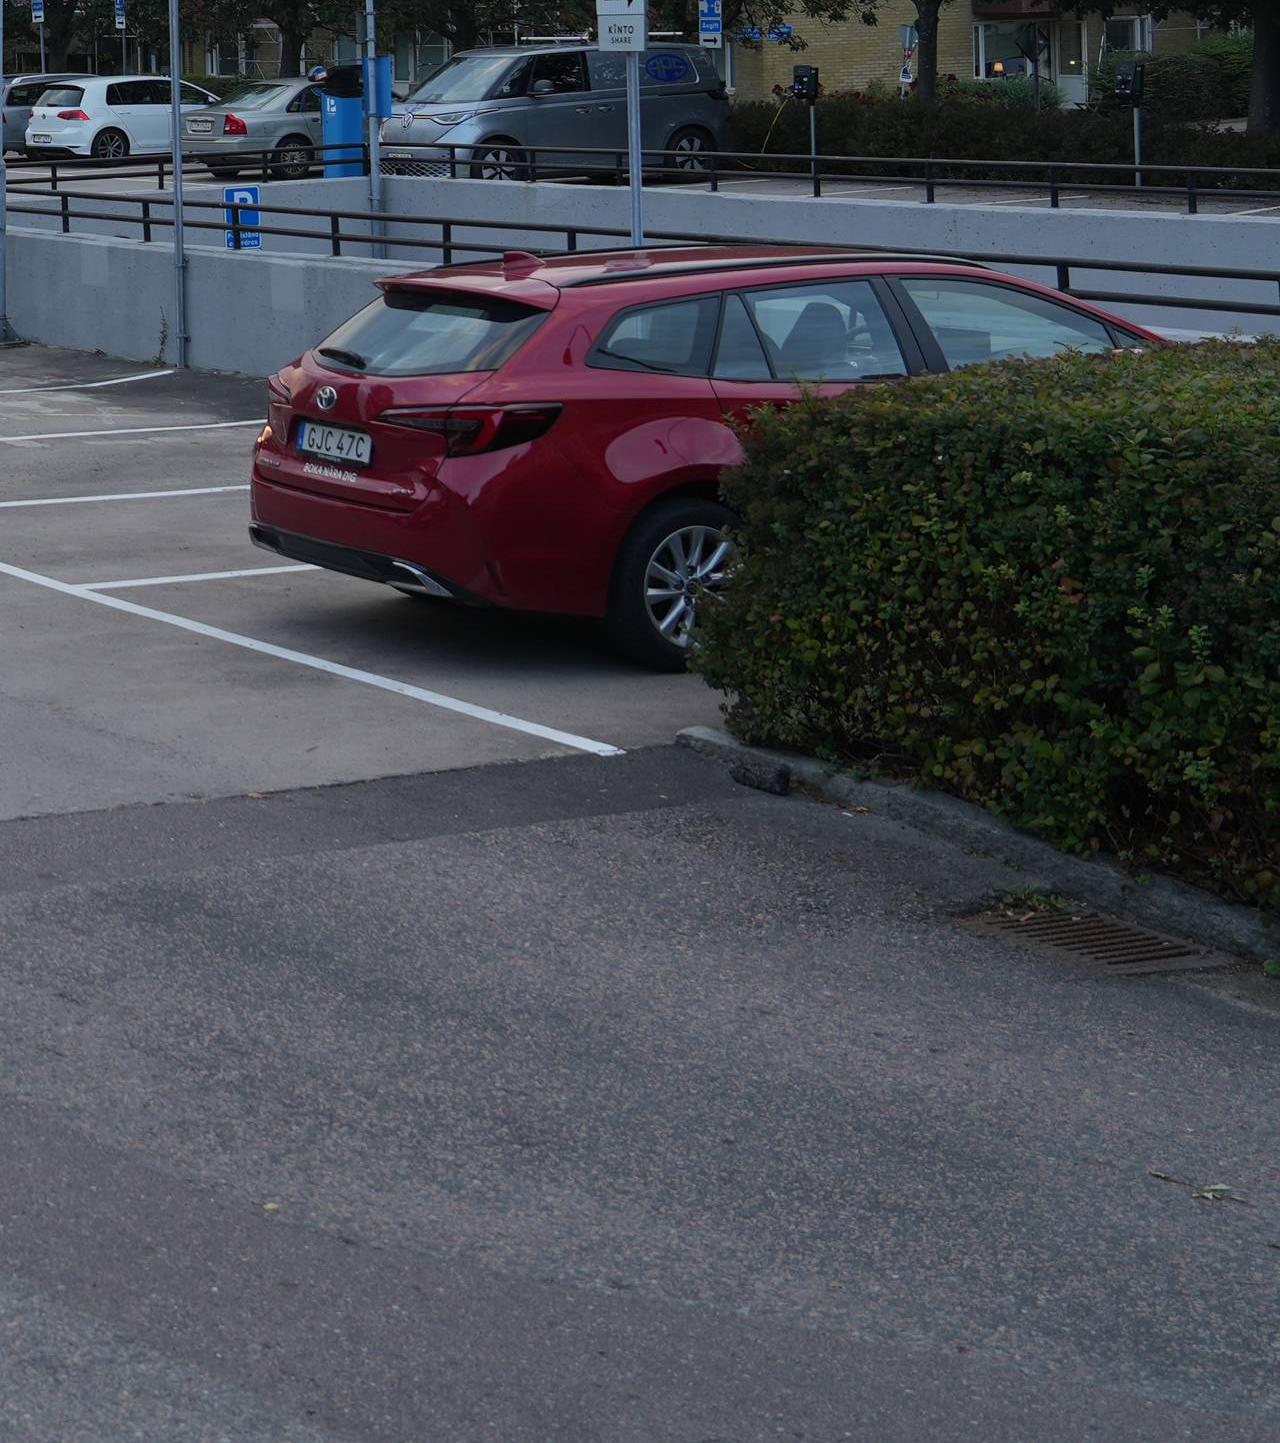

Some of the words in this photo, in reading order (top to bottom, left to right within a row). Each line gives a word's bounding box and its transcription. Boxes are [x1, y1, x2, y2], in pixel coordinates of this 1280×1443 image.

[611, 36, 632, 44] SHARE
[307, 427, 332, 451] GJC
[336, 434, 366, 458] 47C
[303, 462, 321, 475] BOKA
[342, 470, 358, 482] DIG
